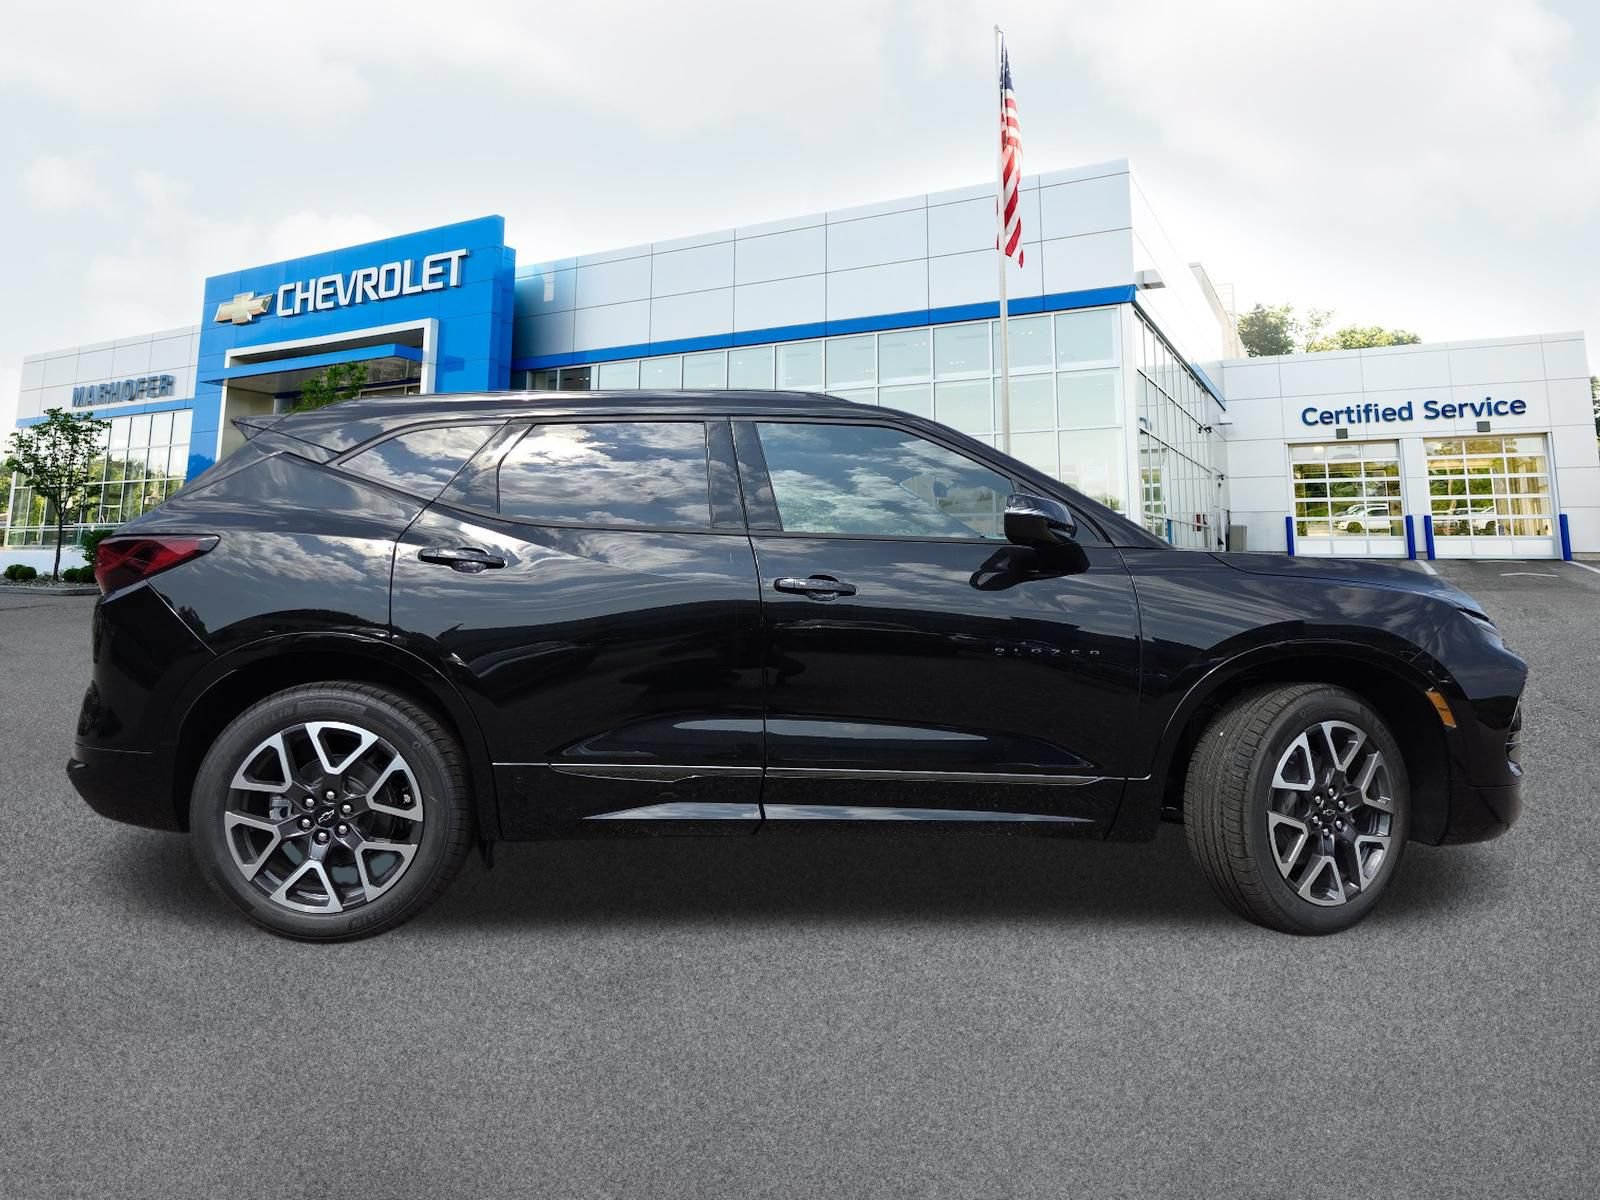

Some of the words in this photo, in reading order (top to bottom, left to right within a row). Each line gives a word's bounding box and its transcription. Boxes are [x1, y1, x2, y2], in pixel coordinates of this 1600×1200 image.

[276, 248, 470, 318] CHEVROLET
[72, 375, 176, 408] MARHOFER
[1301, 401, 1414, 427] Certified
[1423, 397, 1528, 421] Service
